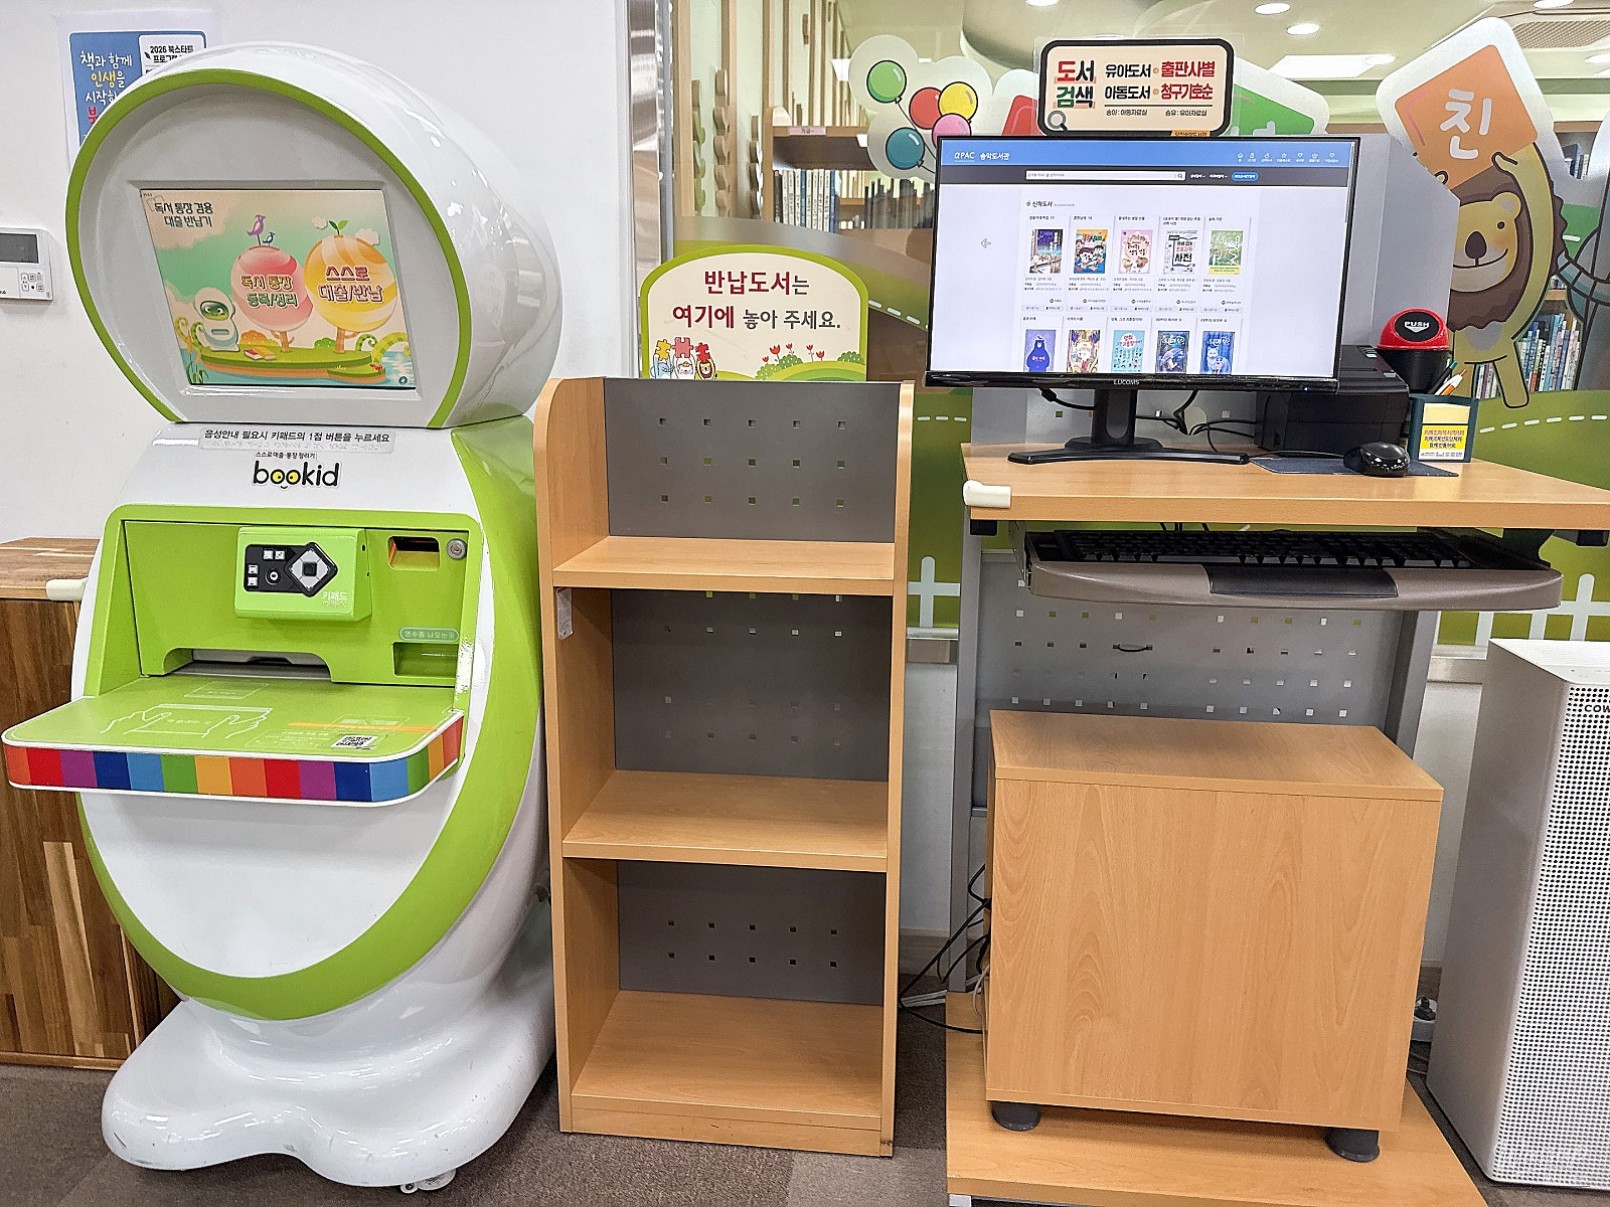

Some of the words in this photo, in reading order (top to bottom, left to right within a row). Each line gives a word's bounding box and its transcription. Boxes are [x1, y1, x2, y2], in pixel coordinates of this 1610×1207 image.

[150, 45, 167, 54] 2026
[168, 44, 194, 54] 북스타트
[80, 51, 106, 70] 책과
[108, 53, 133, 69] 함께
[1057, 60, 1095, 82] 도서
[1105, 64, 1152, 78] 유아도서
[1161, 61, 1215, 78] 출판사별
[91, 72, 126, 88] 인생을
[1056, 86, 1094, 108] 검색
[1104, 85, 1150, 100] 아동도서
[1160, 83, 1213, 100] 청구기호순
[1440, 87, 1492, 160] 친
[154, 202, 174, 214] 독서
[174, 202, 193, 214] 통장
[194, 202, 213, 214] 겸용
[164, 216, 183, 228] 대출
[183, 216, 213, 228] 반납기
[241, 274, 266, 290] 독서
[268, 276, 293, 291] 통장
[325, 266, 370, 282] 스스로
[704, 270, 810, 296] 반납도서는
[318, 284, 384, 302] 대출/반납
[672, 305, 735, 329] 여기에
[742, 310, 778, 330] 놓아
[784, 310, 841, 330] 주세요.
[1404, 320, 1430, 329] PUSH
[204, 430, 240, 440] 음성안내
[242, 430, 268, 440] 필요시
[271, 431, 306, 441] 키패드의
[309, 432, 323, 442] 1점
[326, 433, 352, 443] 버튼을
[354, 434, 390, 443] 누르세요
[252, 460, 340, 487] bookid
[322, 591, 347, 601] 키패드
